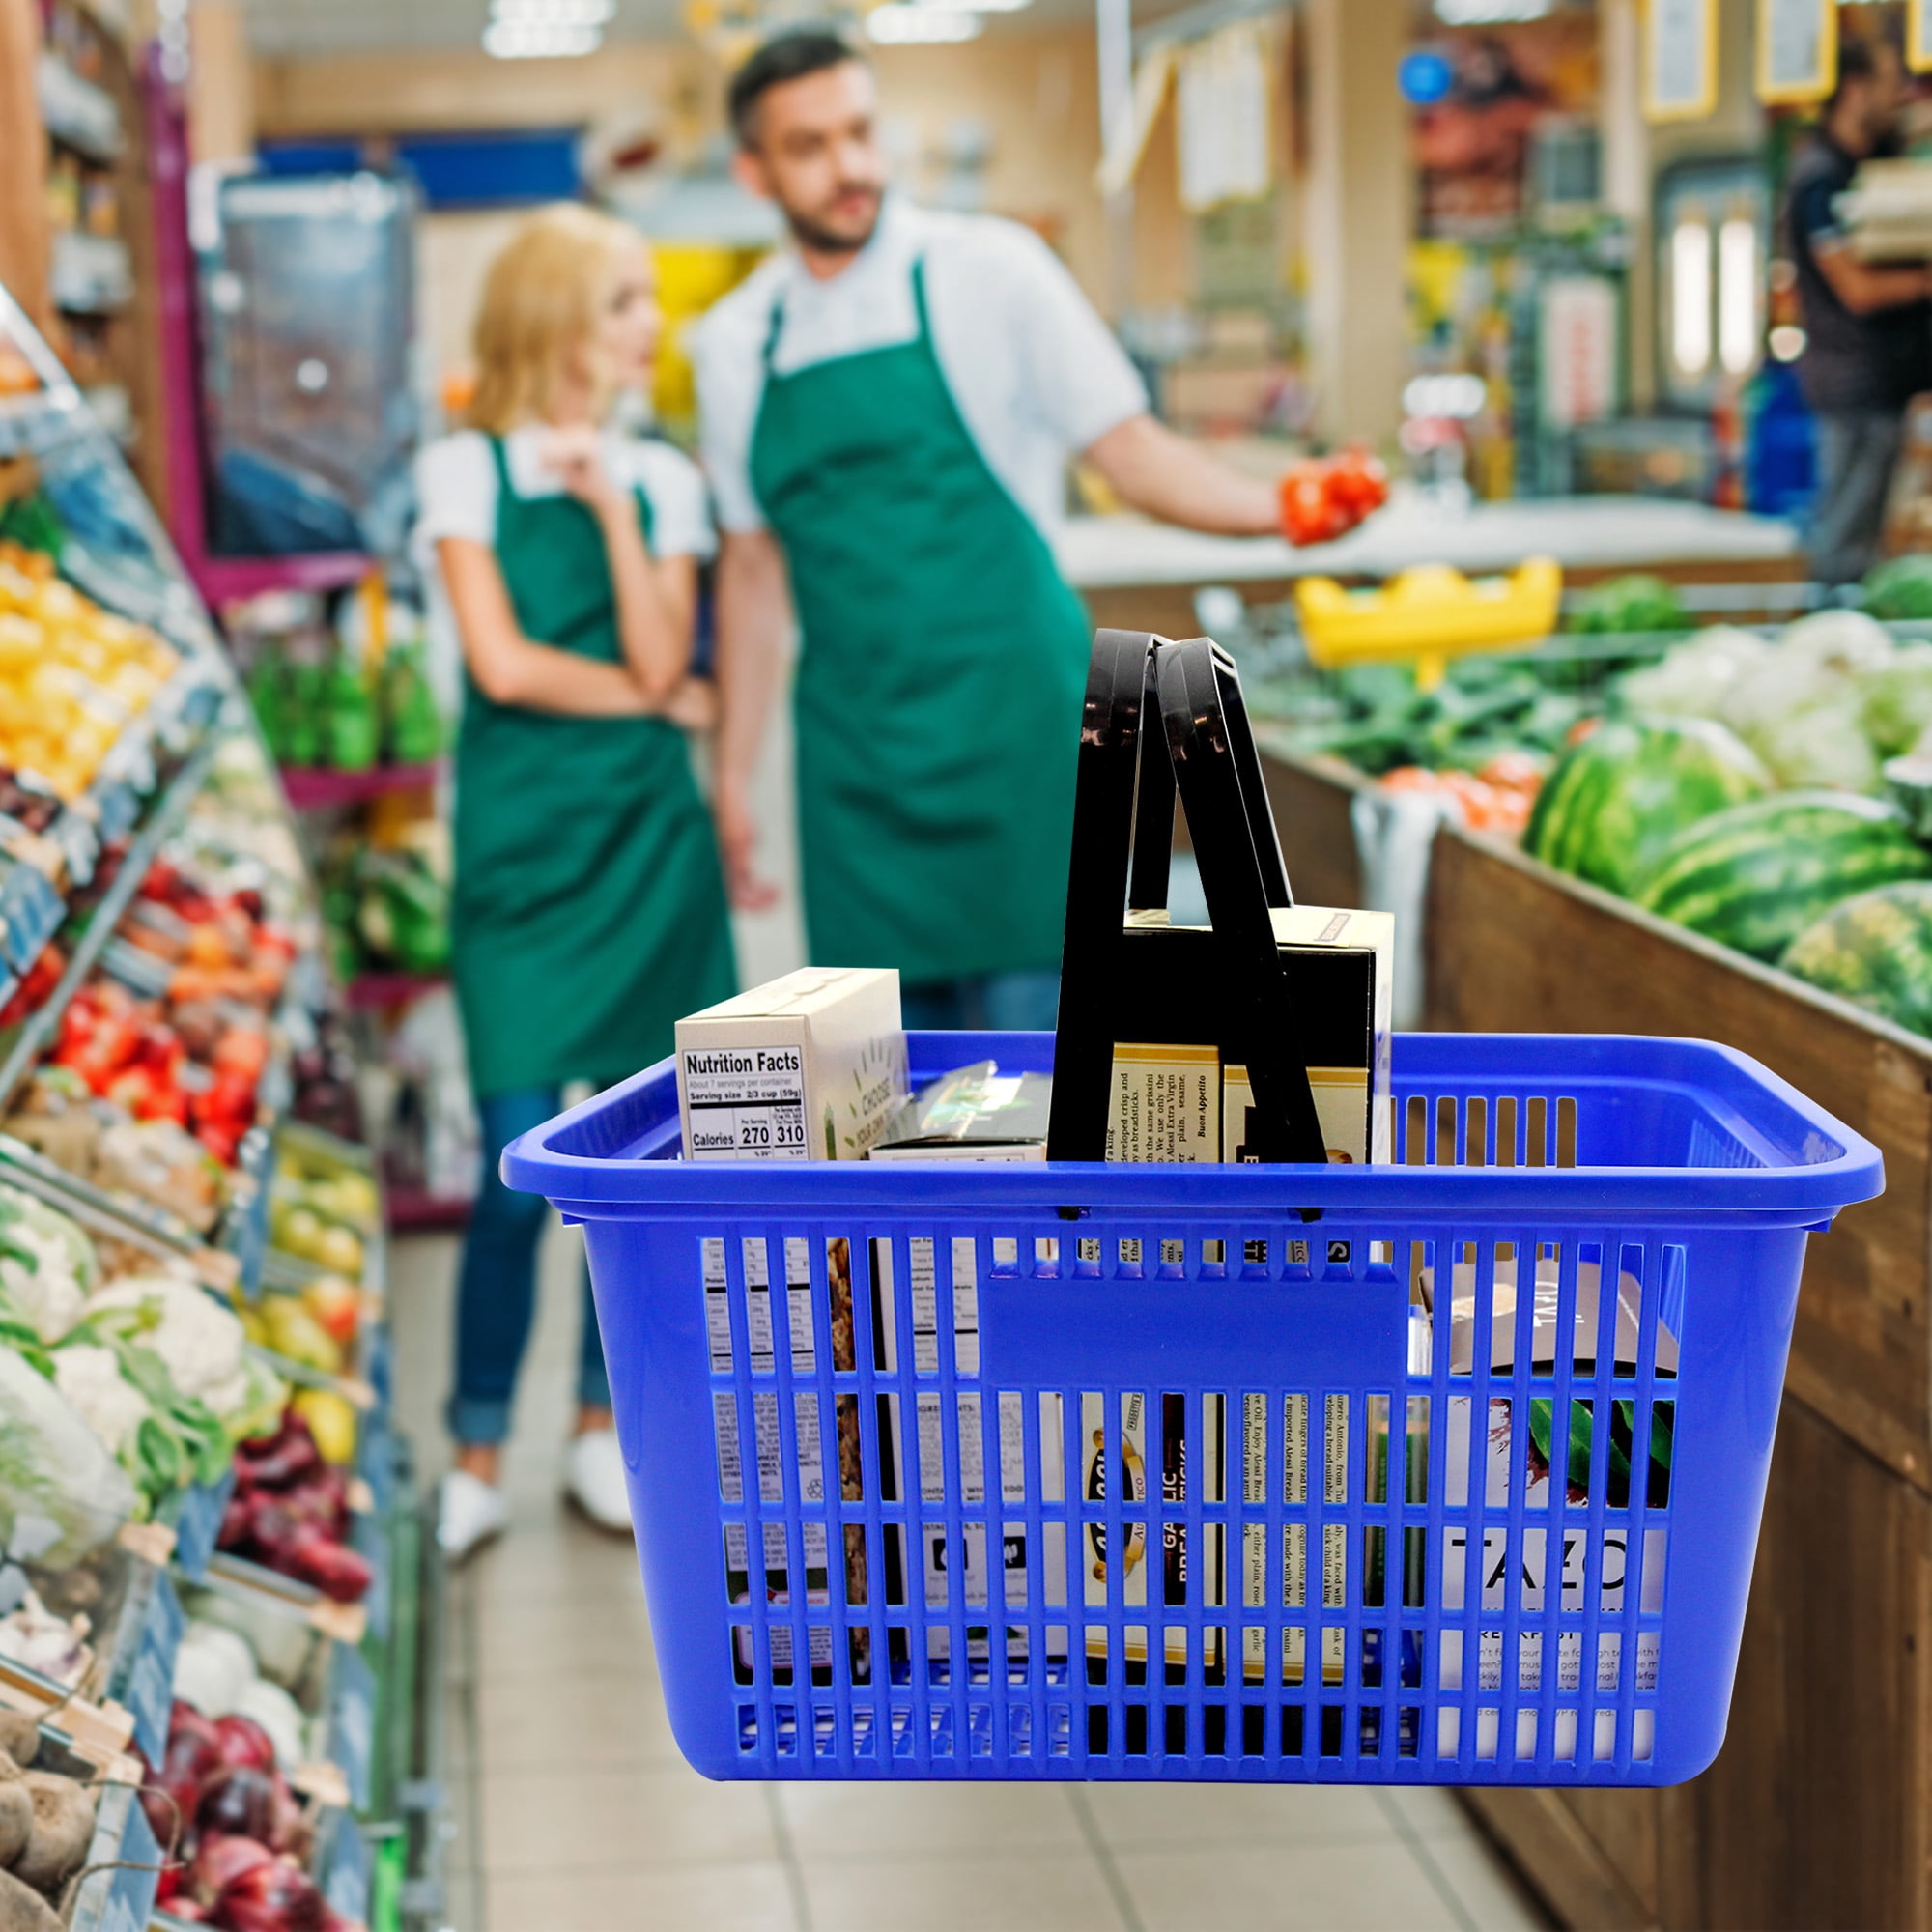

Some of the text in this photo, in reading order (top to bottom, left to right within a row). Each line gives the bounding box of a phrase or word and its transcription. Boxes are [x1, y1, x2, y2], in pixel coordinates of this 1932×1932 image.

[687, 1052, 800, 1074] Nutrition Facts
[690, 1092, 722, 1101] Serving
[746, 1090, 759, 1098] 2/3
[761, 1091, 777, 1099] cup
[780, 1088, 801, 1098] (59g)
[717, 1079, 746, 1090] servings
[759, 1077, 792, 1087] container
[1146, 1073, 1155, 1107] grissini
[1167, 1074, 1177, 1102] Virgin
[1121, 1093, 1129, 1116] crisp
[1156, 1094, 1165, 1113] only
[1197, 1075, 1208, 1138] Buon Appetito
[693, 1125, 804, 1146] Calories 270 310
[1178, 1116, 1186, 1142] plain,
[1132, 1144, 1138, 1152] as
[1156, 1137, 1164, 1151] We
[1284, 1403, 1293, 1443] imported
[1252, 1426, 1262, 1450] Enjoy
[1336, 1424, 1345, 1462] Antonio,
[1243, 1456, 1249, 1466] as
[1285, 1445, 1293, 1469] Alessi
[1243, 1466, 1249, 1478] an
[1336, 1464, 1345, 1486] from
[1162, 1472, 1178, 1548] GALIC
[1253, 1531, 1262, 1556] either
[1251, 1559, 1261, 1584] plain,
[1324, 1568, 1332, 1577] of
[1334, 1562, 1343, 1584] faced
[1323, 1584, 1332, 1605] king.
[1334, 1587, 1343, 1606] with
[1252, 1629, 1261, 1652] garlic
[1333, 1646, 1342, 1656] of
